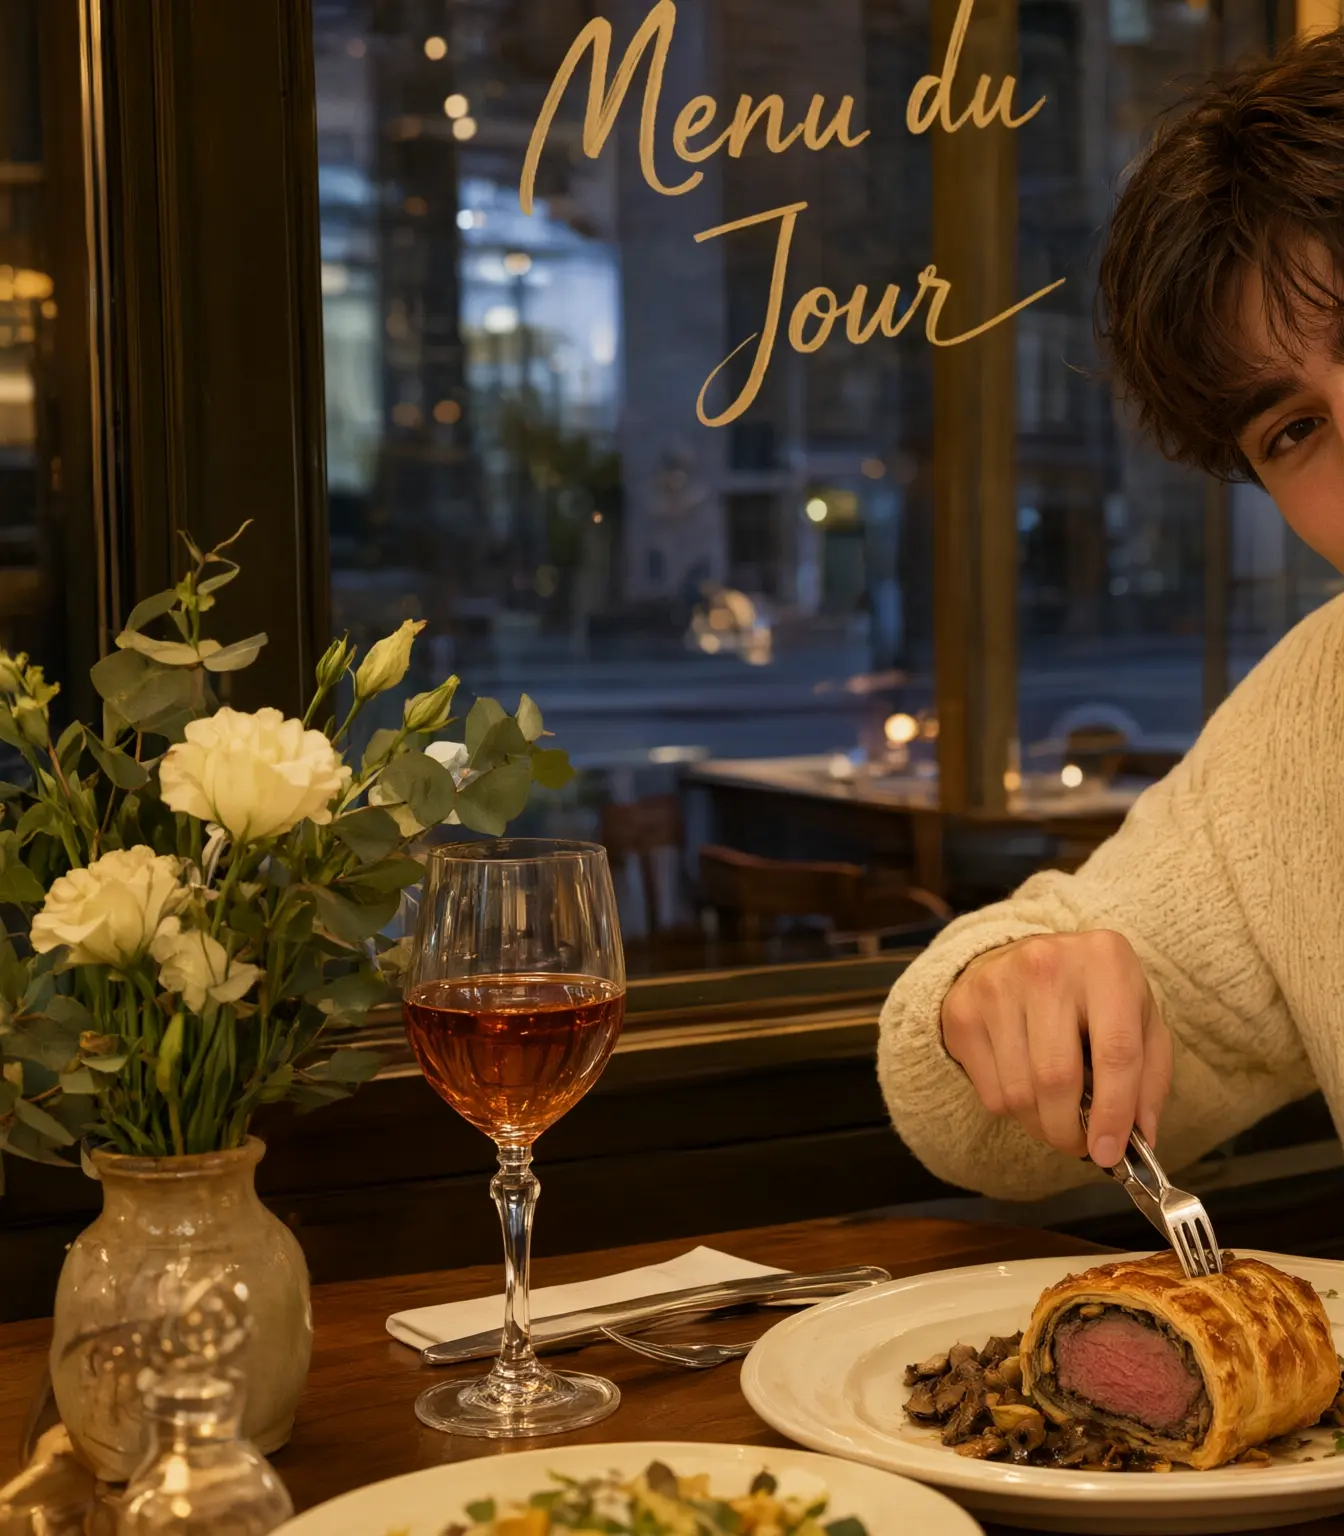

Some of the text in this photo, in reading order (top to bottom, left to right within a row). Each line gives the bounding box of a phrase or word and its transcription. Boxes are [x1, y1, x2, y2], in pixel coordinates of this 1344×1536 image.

[519, 0, 1046, 216] Menu du
[694, 201, 1066, 427] Jour
